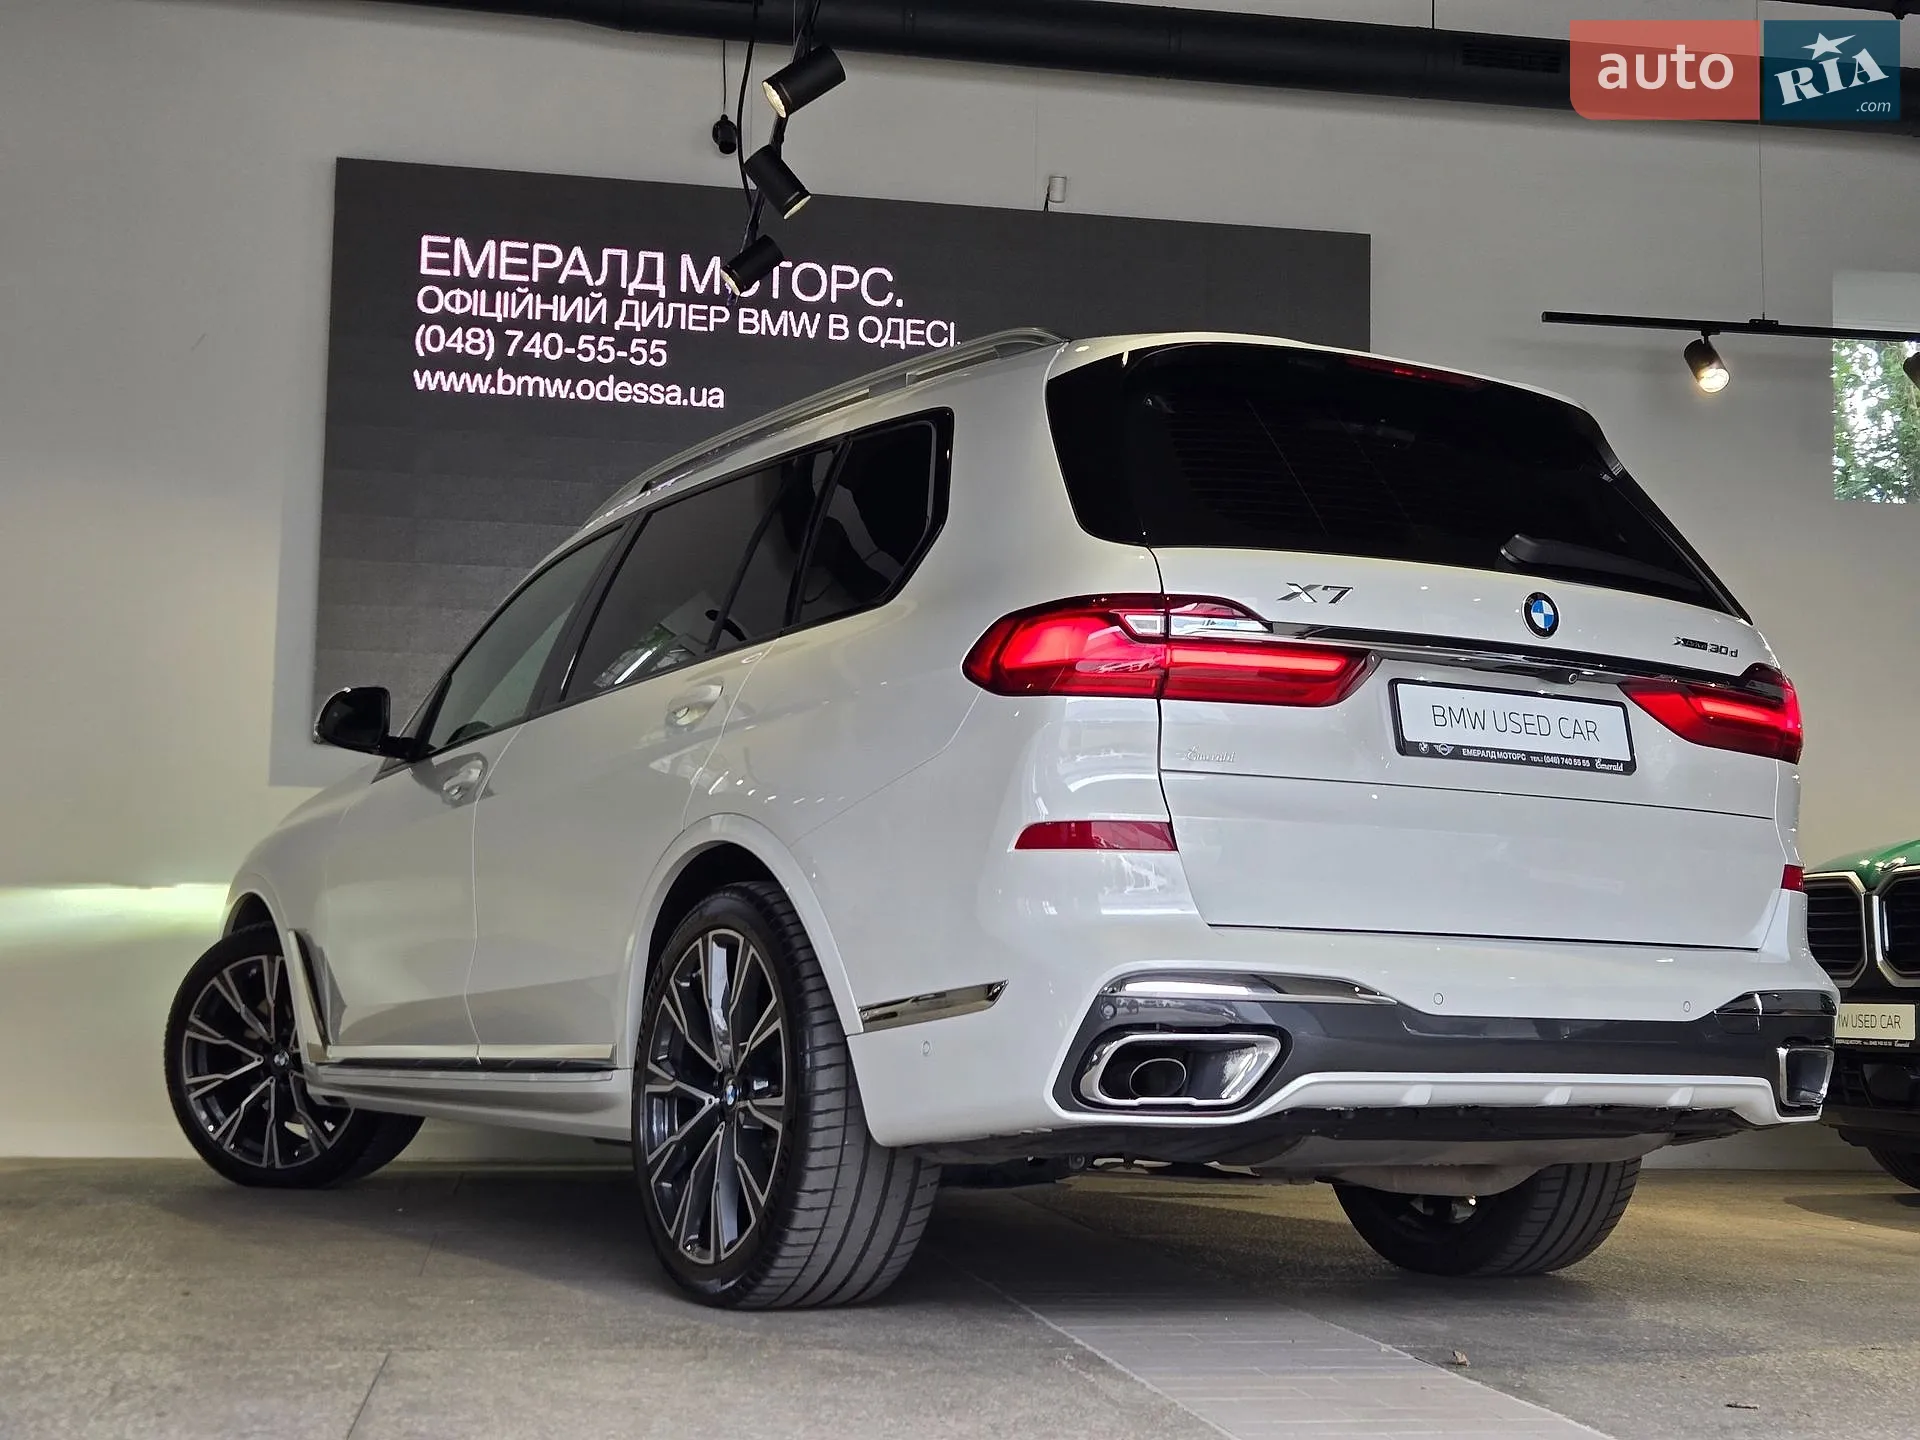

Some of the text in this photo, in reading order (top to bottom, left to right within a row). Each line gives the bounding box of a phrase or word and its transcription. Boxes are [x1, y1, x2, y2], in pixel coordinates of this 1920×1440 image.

[420, 234, 904, 308] ЕМЕРАЛД МТОРС.
[416, 285, 963, 350] ОФІЦІЙНИЙ ДИЛЕР BMW В ОДЕСІ.
[414, 323, 669, 368] (048) 740-55-55
[412, 367, 726, 409] www.bmw.odessa.ua
[1276, 581, 1355, 605] X7
[1431, 704, 1600, 742] BMW USED CAR
[1462, 748, 1497, 759] ЕМЕРАЛД
[1496, 752, 1527, 761] МОТОРС
[1594, 758, 1624, 772] Emerald
[1851, 1014, 1877, 1029] USED
[1880, 1014, 1902, 1030] CAR
